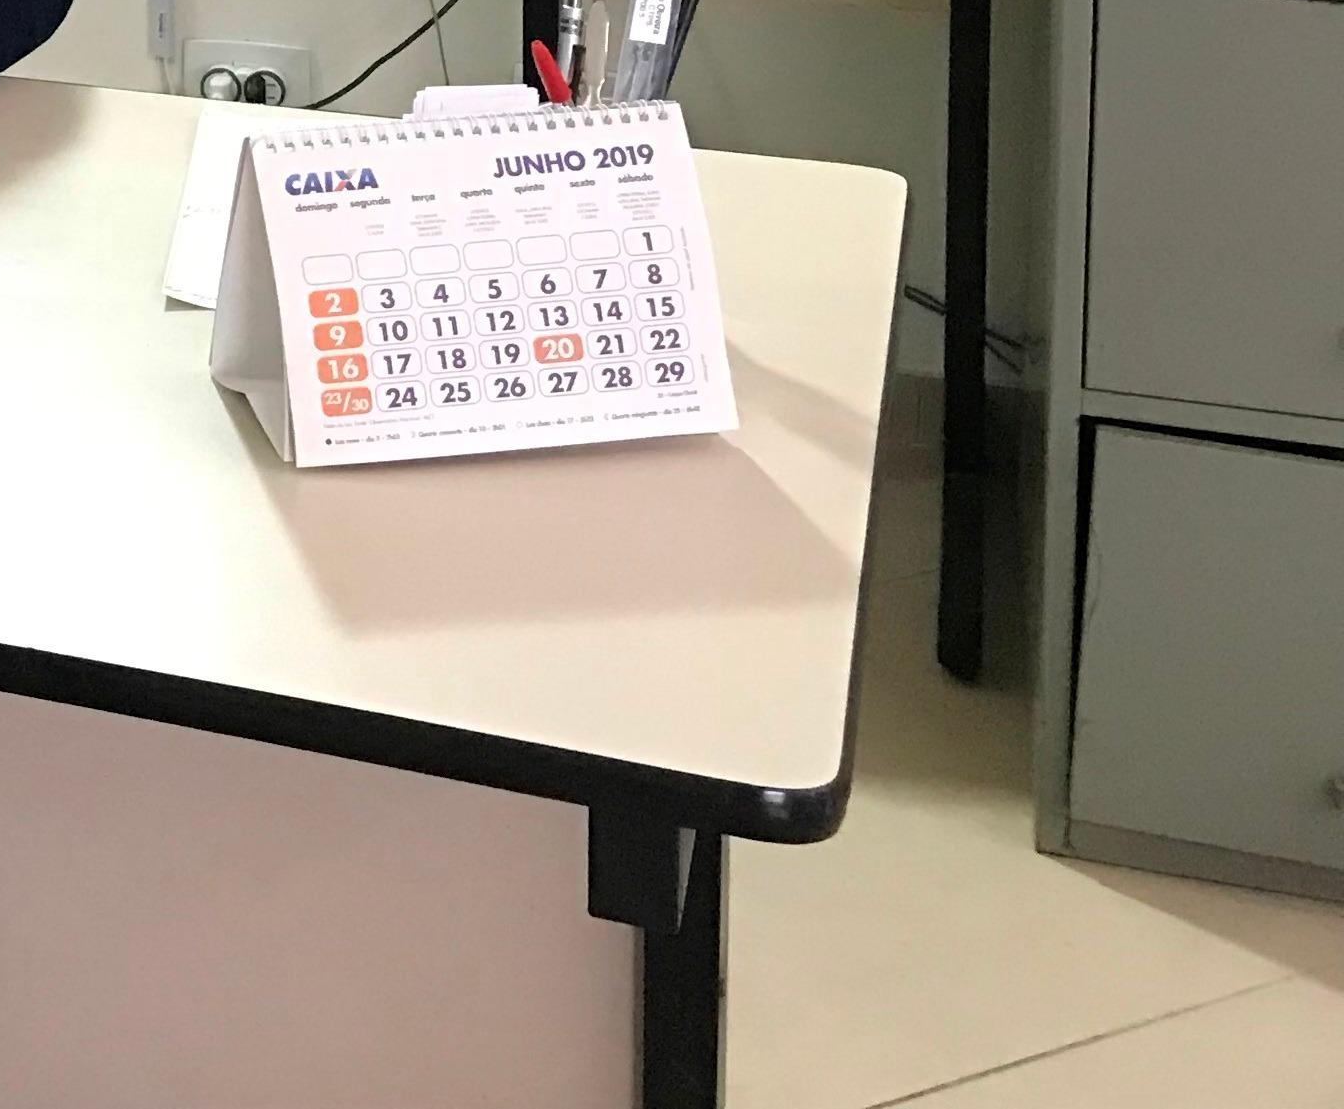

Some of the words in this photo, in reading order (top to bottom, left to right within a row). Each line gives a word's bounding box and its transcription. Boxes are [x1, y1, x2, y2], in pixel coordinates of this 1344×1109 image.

[285, 168, 379, 196] CAIXA
[493, 150, 586, 178] JUNHO
[593, 144, 654, 169] 2019
[295, 201, 338, 213] domingo
[350, 196, 391, 209] segunda
[460, 188, 493, 199] quarta
[514, 183, 545, 195] quinta
[642, 232, 654, 252] 1
[324, 292, 342, 313] 2
[380, 288, 395, 309] 3
[433, 284, 449, 304] 4
[488, 279, 502, 300] 5
[540, 273, 556, 295] 6
[592, 268, 608, 290] 7
[647, 263, 663, 285] 8
[328, 325, 346, 346] 9
[378, 320, 408, 342] 10
[432, 315, 459, 337] 11
[486, 310, 516, 332] 12
[539, 305, 569, 327] 13
[593, 301, 623, 322] 14
[646, 296, 676, 317] 15
[327, 358, 360, 380] 16
[383, 353, 412, 375] 17
[437, 348, 467, 370] 18
[491, 343, 520, 365] 19
[541, 337, 576, 360] 20
[596, 334, 624, 355] 21
[650, 328, 682, 351] 22
[324, 391, 369, 413] 23/30
[385, 386, 418, 409] 24
[440, 381, 472, 404] 25
[494, 376, 527, 399] 26
[547, 371, 578, 394] 27
[601, 366, 633, 389] 28
[654, 361, 685, 384] 29
